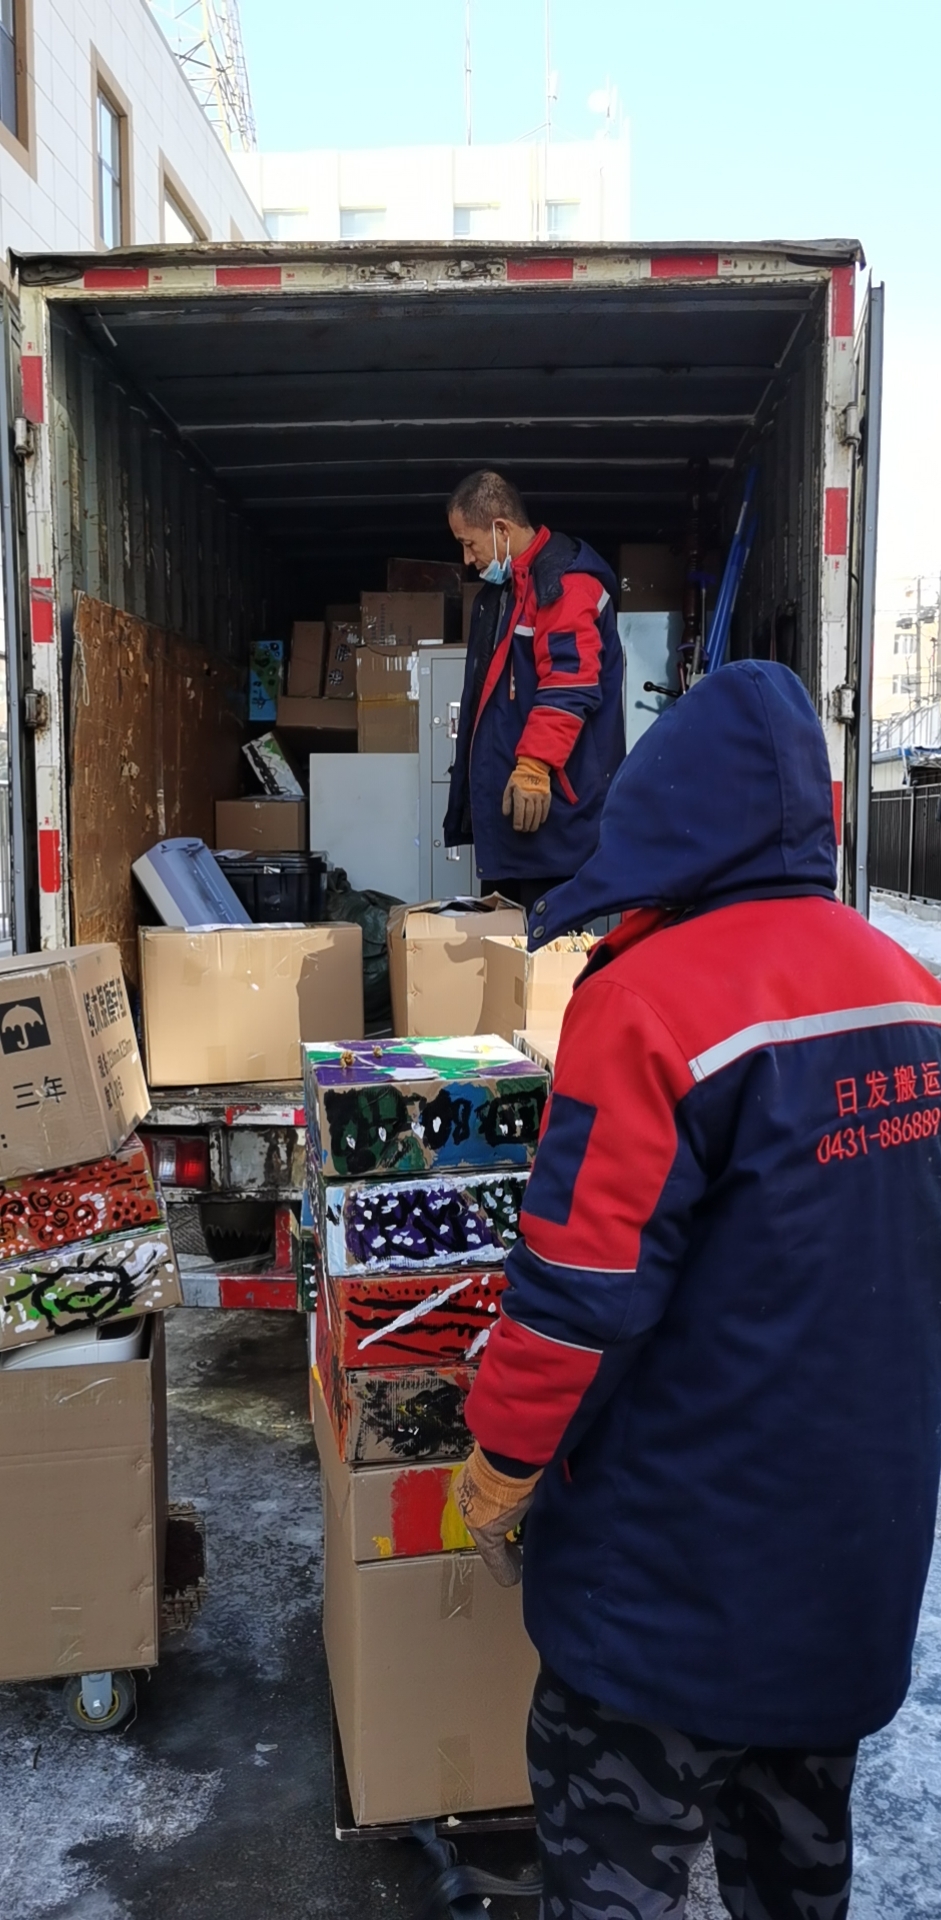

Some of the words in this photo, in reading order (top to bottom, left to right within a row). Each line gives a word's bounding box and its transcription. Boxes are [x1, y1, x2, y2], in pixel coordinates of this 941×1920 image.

[13, 1076, 67, 1110] 三年
[836, 1062, 941, 1117] 日发搬运
[817, 1107, 941, 1164] 0431-886889
